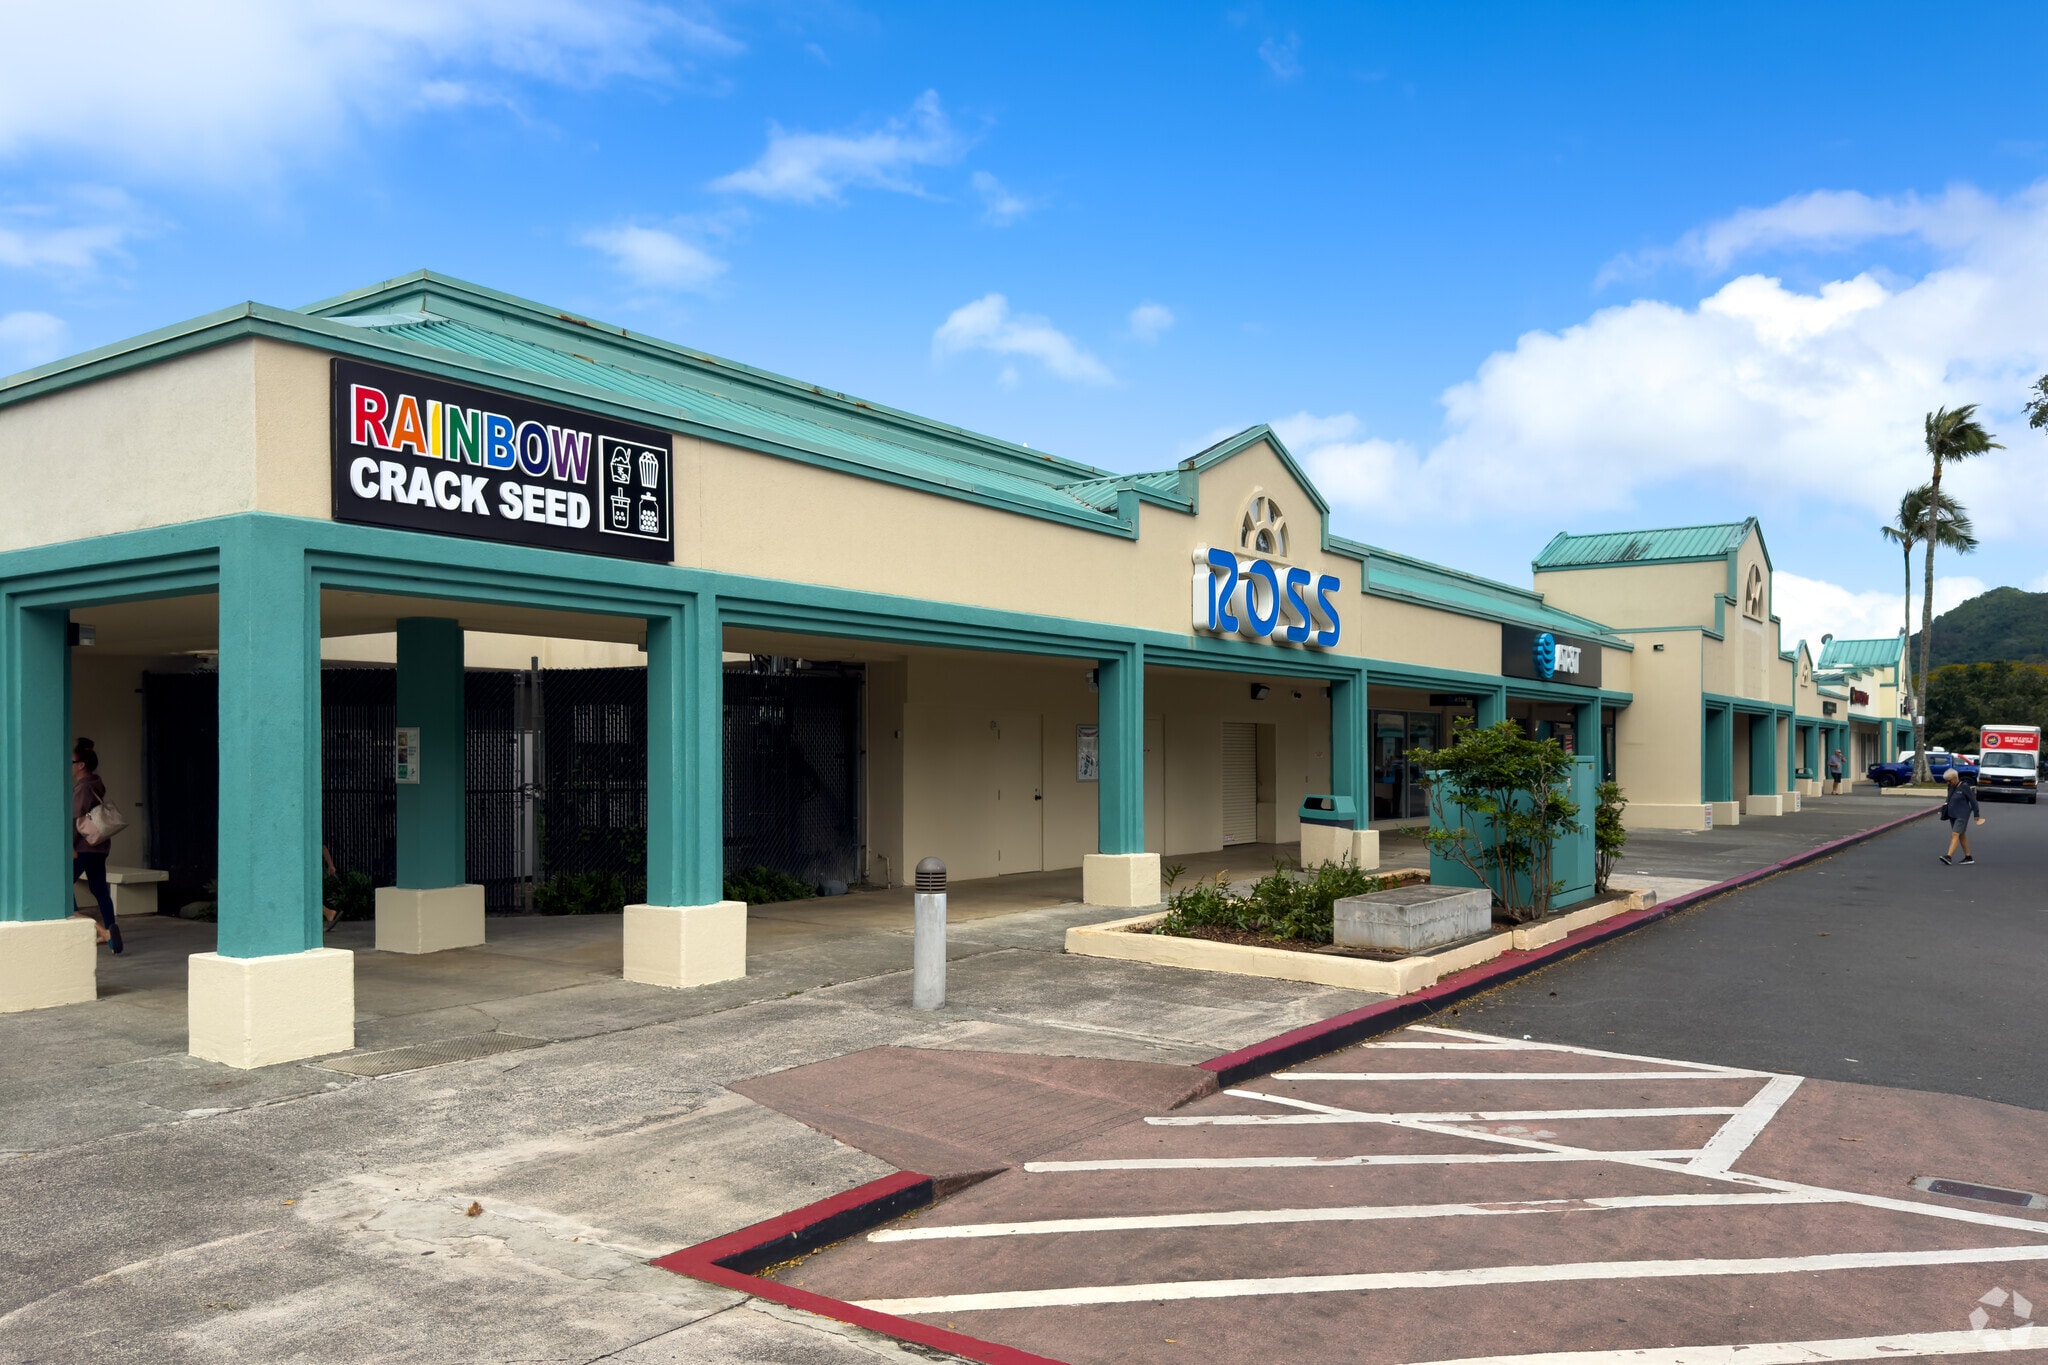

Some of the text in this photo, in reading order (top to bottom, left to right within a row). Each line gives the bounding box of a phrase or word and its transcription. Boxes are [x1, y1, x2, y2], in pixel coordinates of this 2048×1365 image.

[350, 383, 593, 485] RAINBOW
[350, 456, 591, 529] CRACK SEED
[1192, 546, 1341, 648] ROSS
[1555, 644, 1582, 674] AT&T
